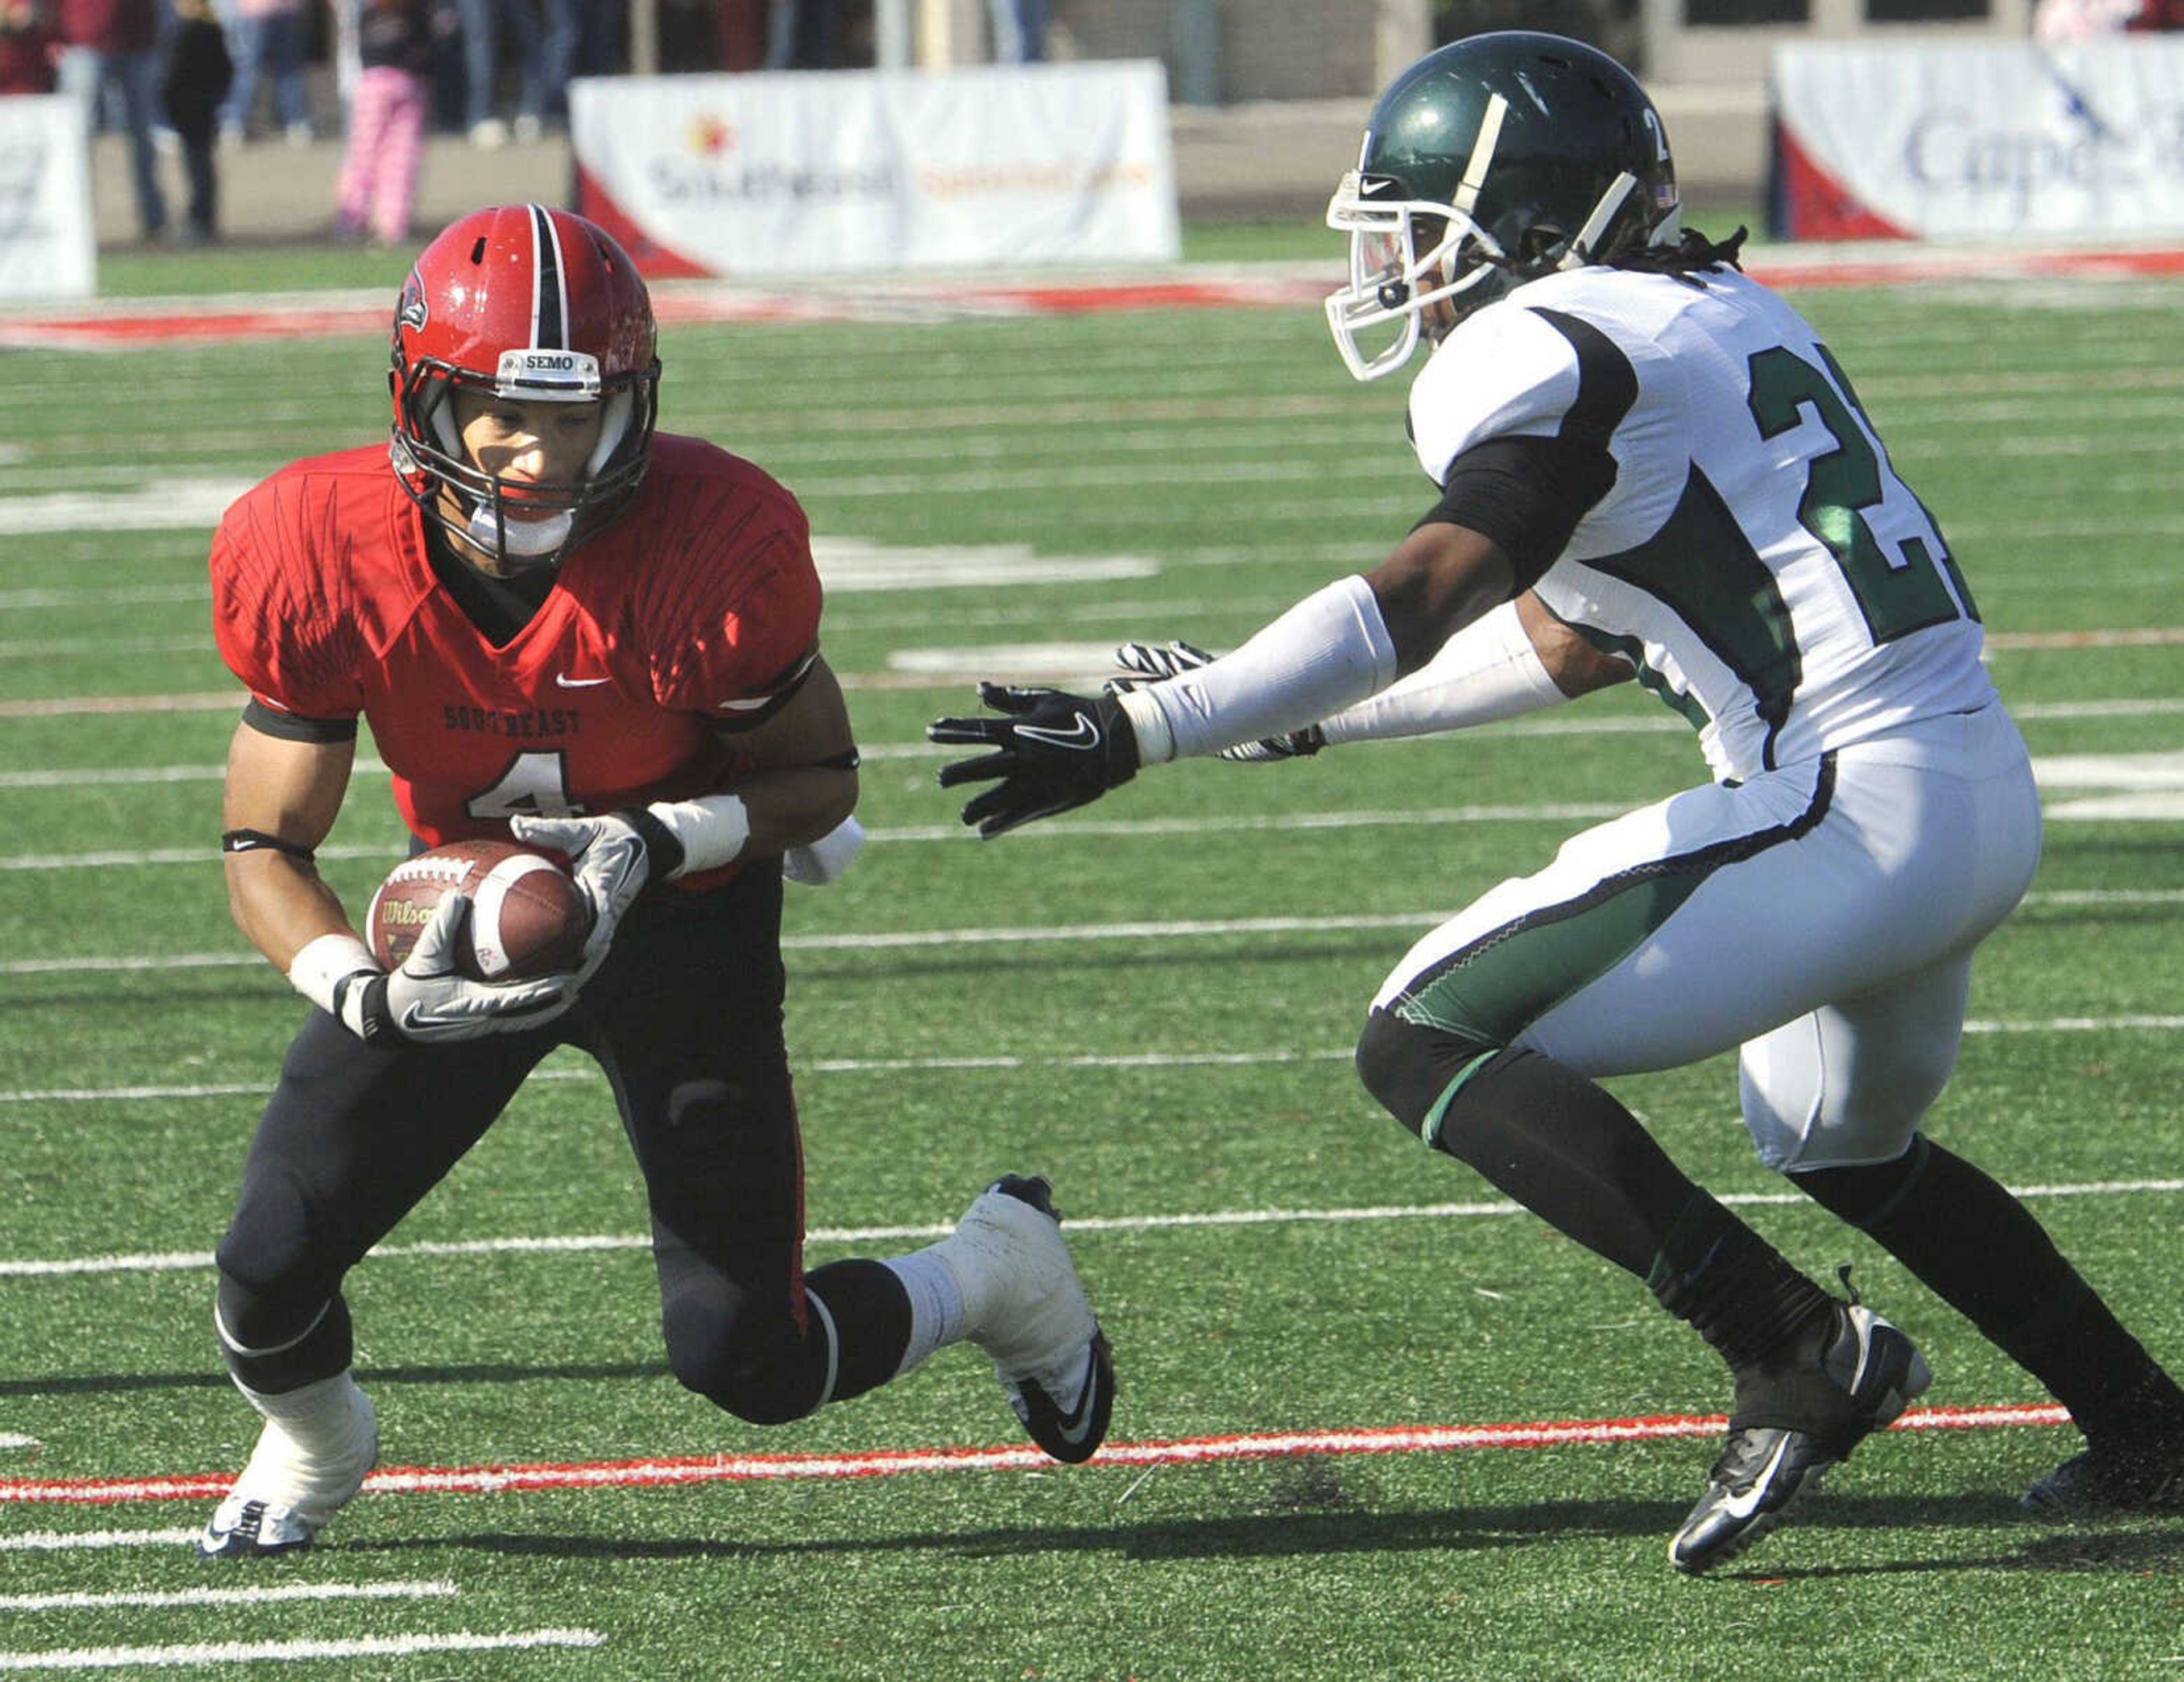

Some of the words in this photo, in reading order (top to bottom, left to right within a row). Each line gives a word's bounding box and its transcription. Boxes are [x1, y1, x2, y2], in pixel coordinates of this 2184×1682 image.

[527, 355, 573, 370] SEMO
[464, 748, 590, 819] 4
[382, 900, 439, 925] Wilso
